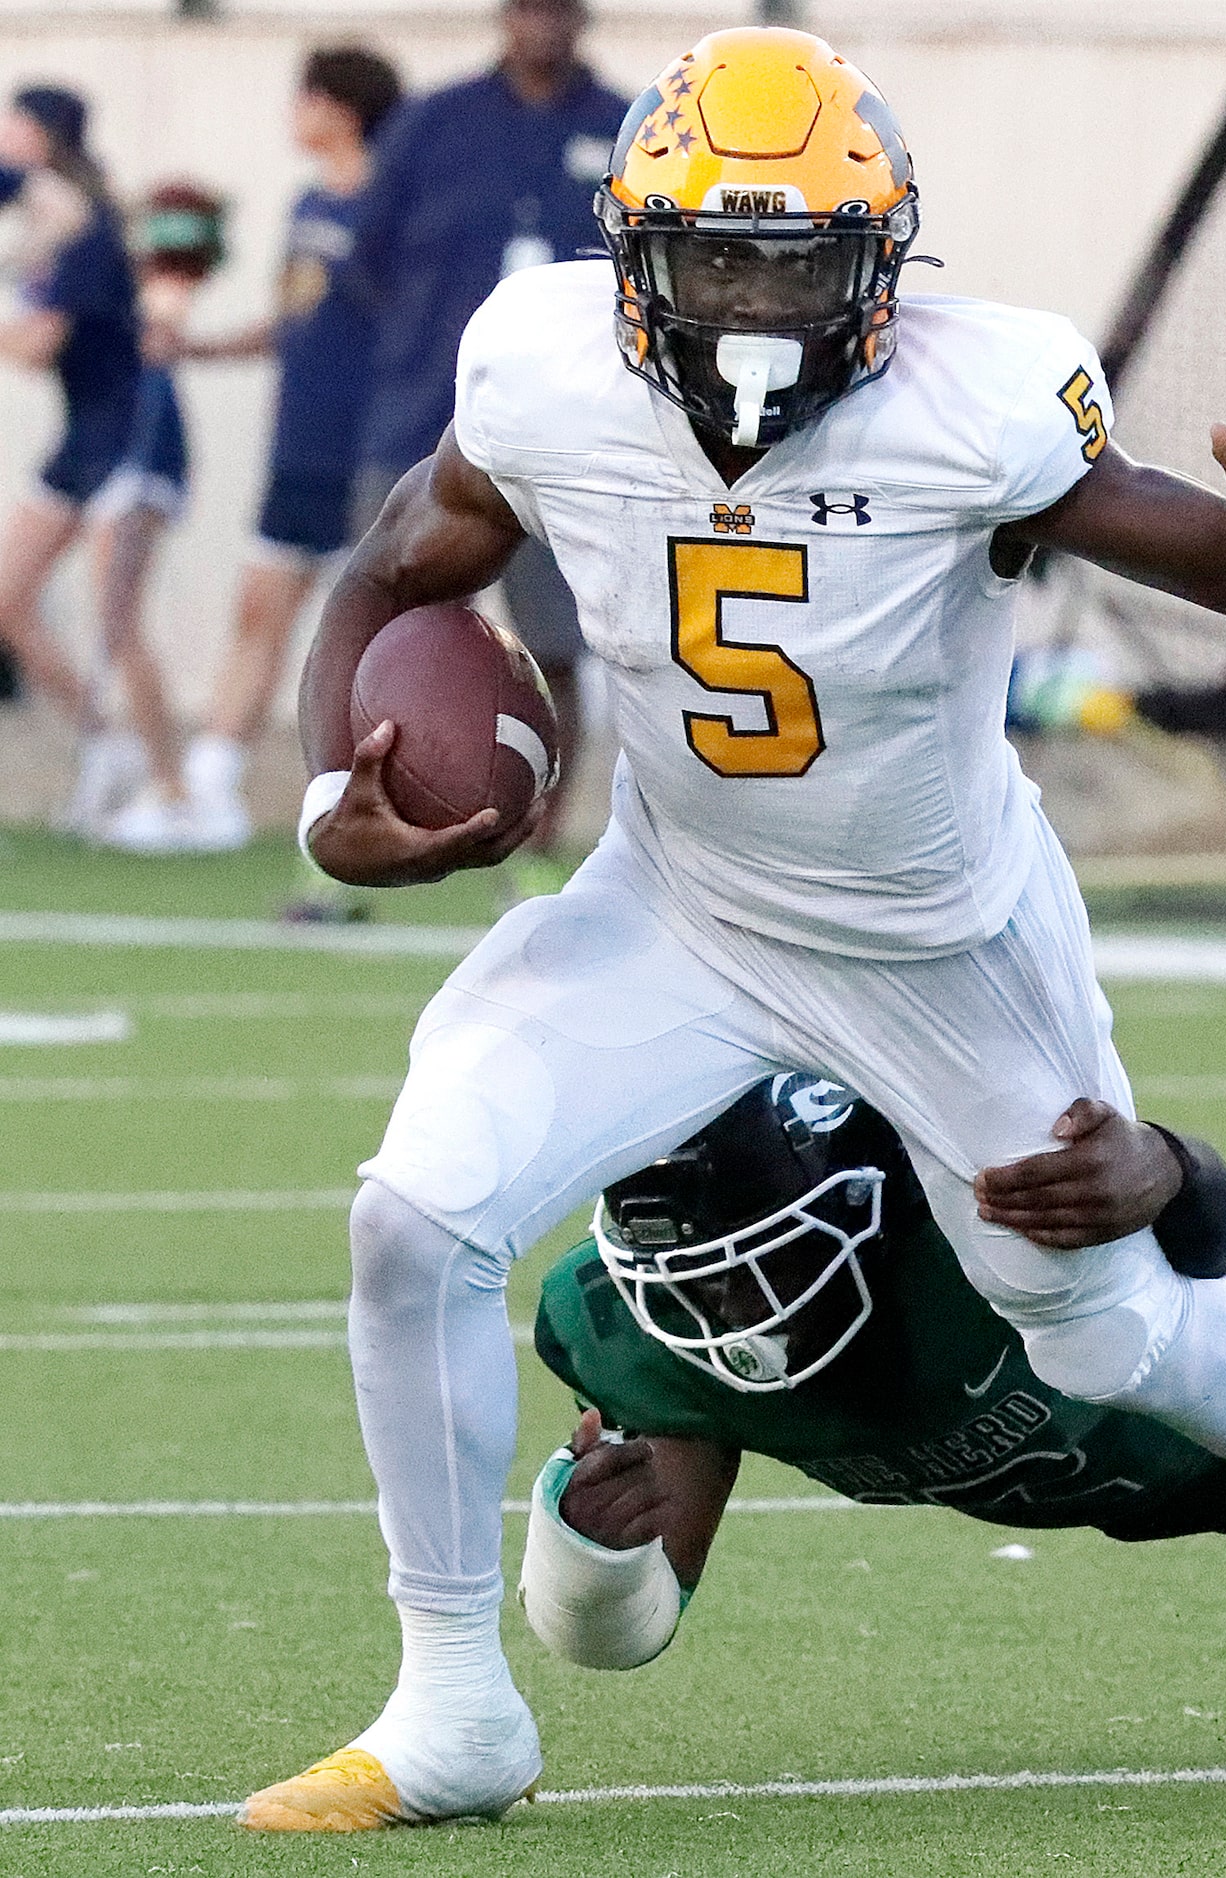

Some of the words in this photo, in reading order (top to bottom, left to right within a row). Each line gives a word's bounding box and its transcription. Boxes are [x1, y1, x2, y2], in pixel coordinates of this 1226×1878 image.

[720, 189, 785, 213] WAWG
[1056, 364, 1108, 463] 5
[711, 514, 753, 524] LIONS
[667, 536, 826, 777] 5
[905, 1391, 1051, 1482] HERD
